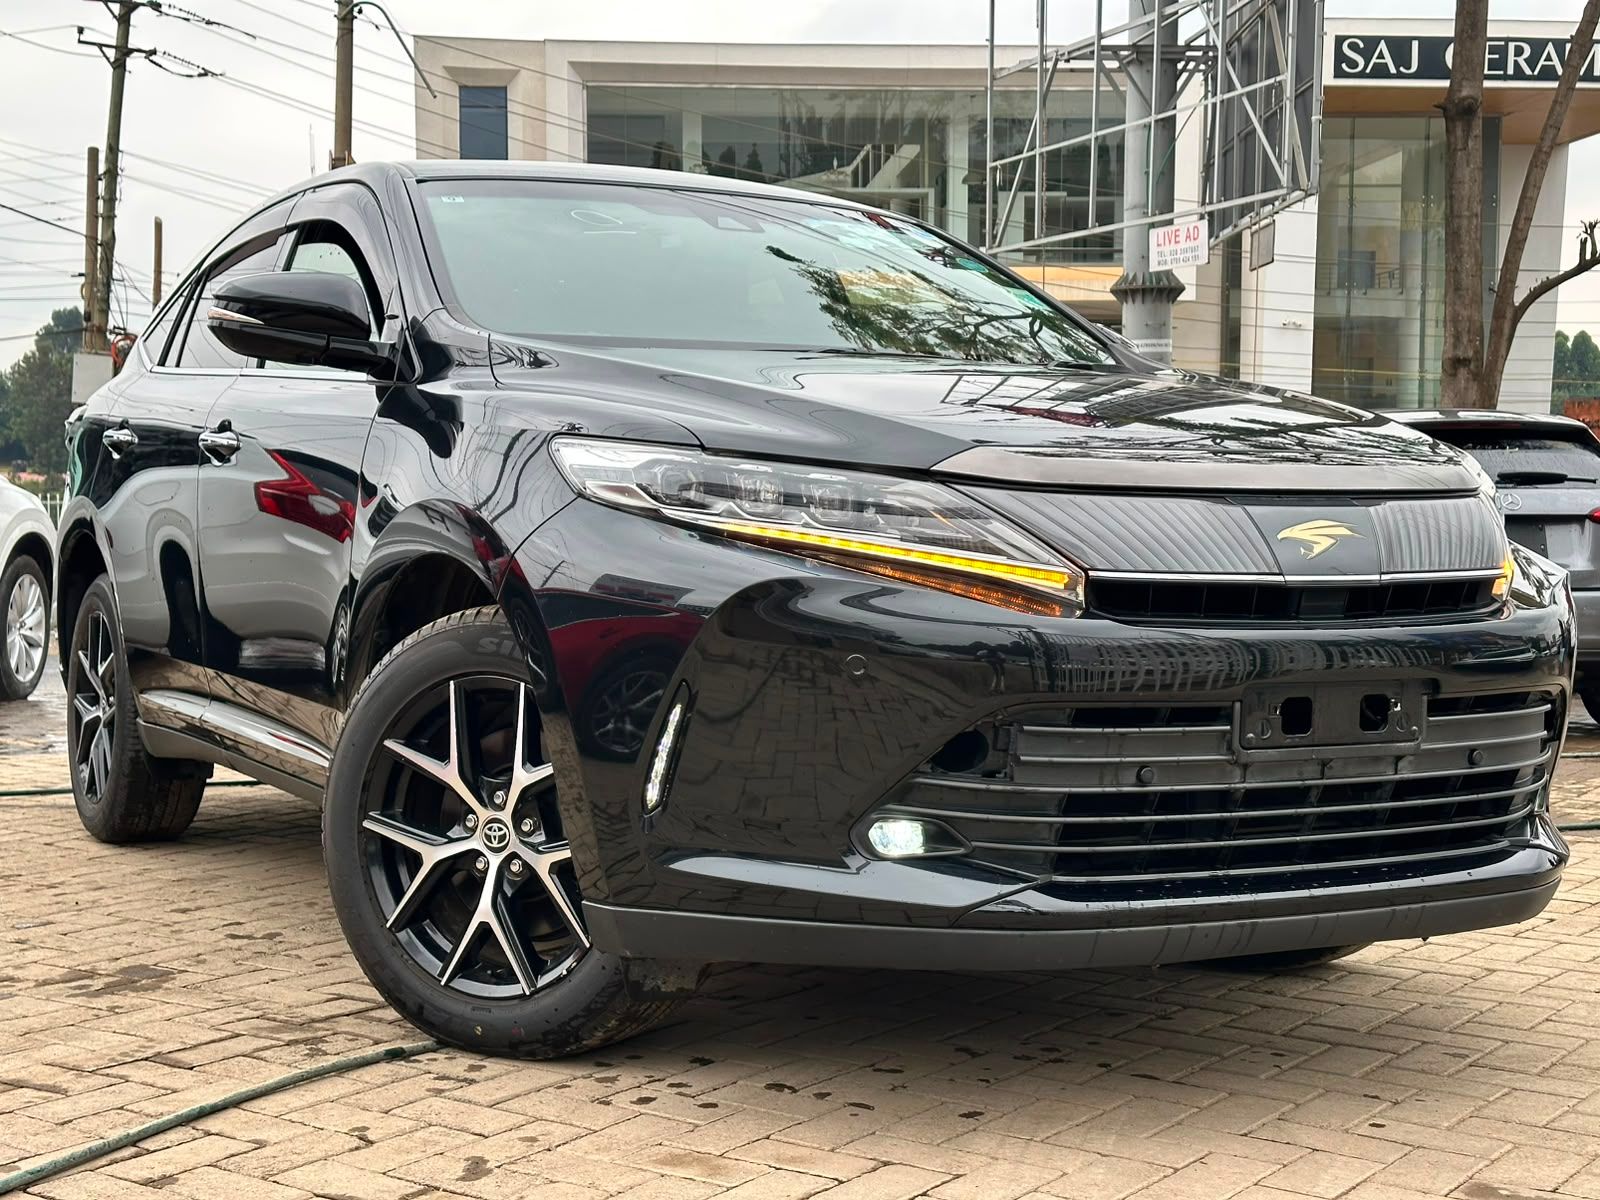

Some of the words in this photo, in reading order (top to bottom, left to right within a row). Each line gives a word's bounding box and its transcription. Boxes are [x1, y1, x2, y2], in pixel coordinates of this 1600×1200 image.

[1341, 38, 1419, 74] SAJ
[1445, 41, 1600, 76] ERAM
[1157, 229, 1180, 247] LIVE
[1185, 225, 1199, 242] AD
